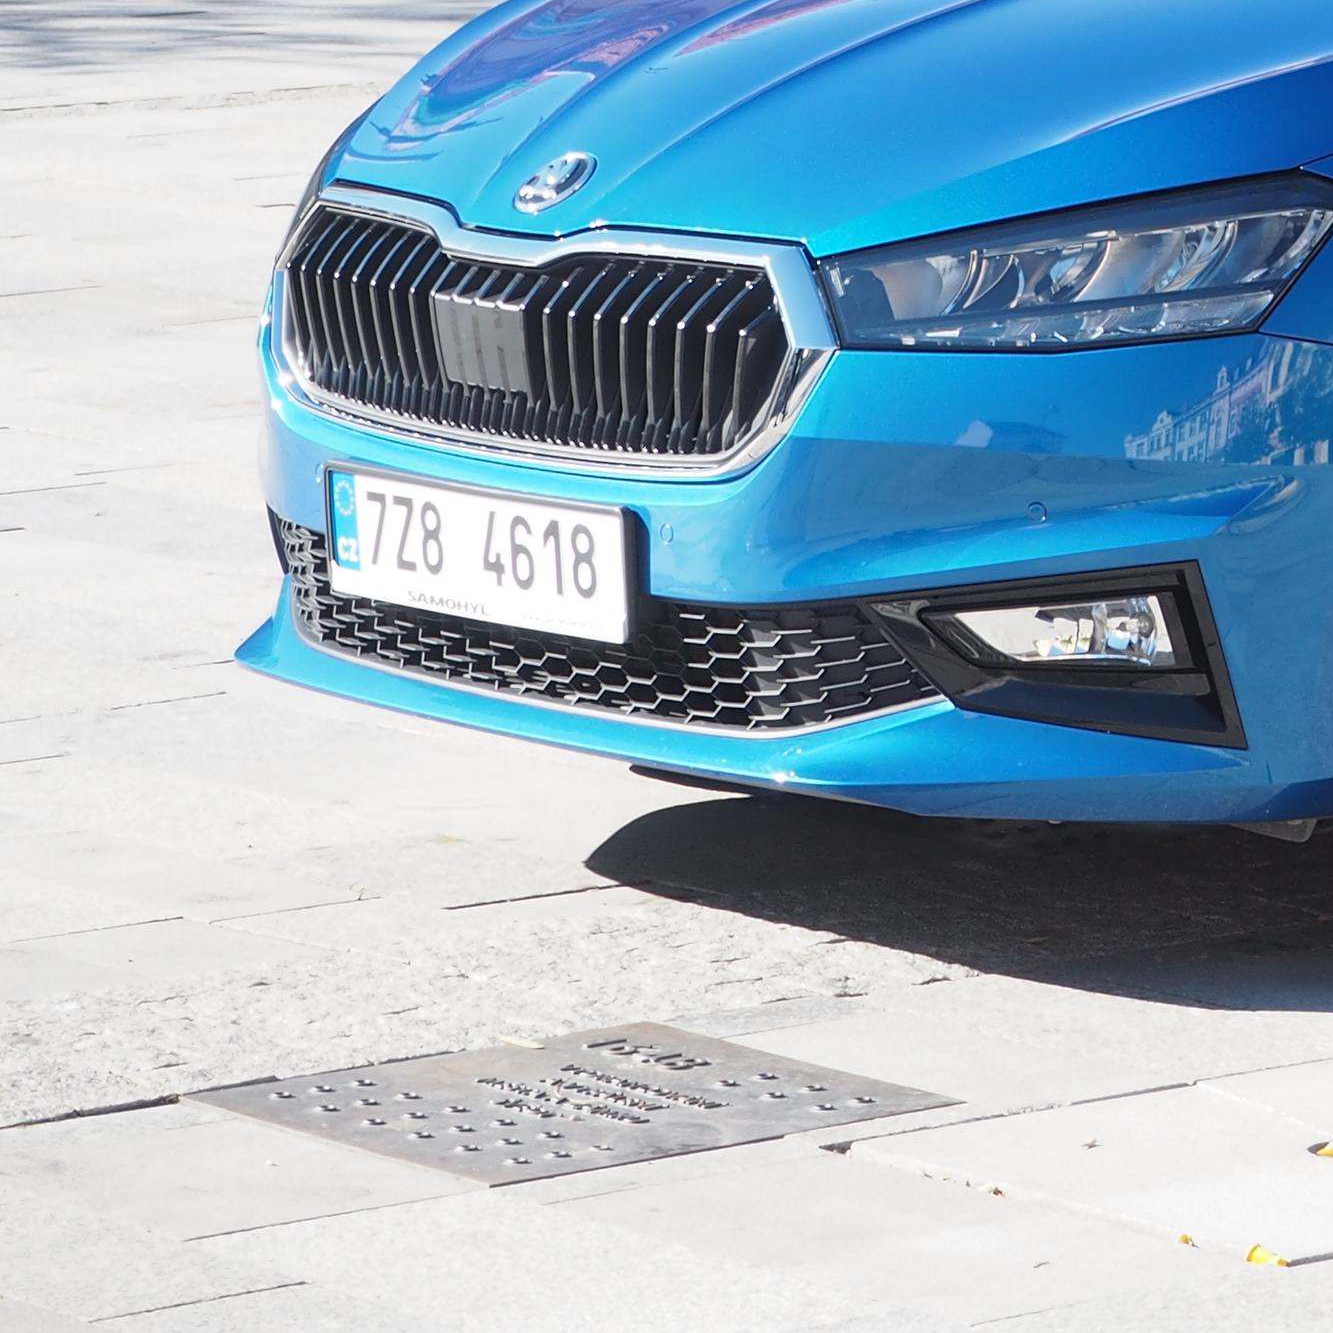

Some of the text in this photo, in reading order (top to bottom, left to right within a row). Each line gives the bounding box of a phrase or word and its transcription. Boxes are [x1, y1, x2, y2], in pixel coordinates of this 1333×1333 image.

[338, 536, 359, 563] CZ
[366, 491, 598, 600] 7Z8 4618
[407, 590, 490, 617] SAMOHYL
